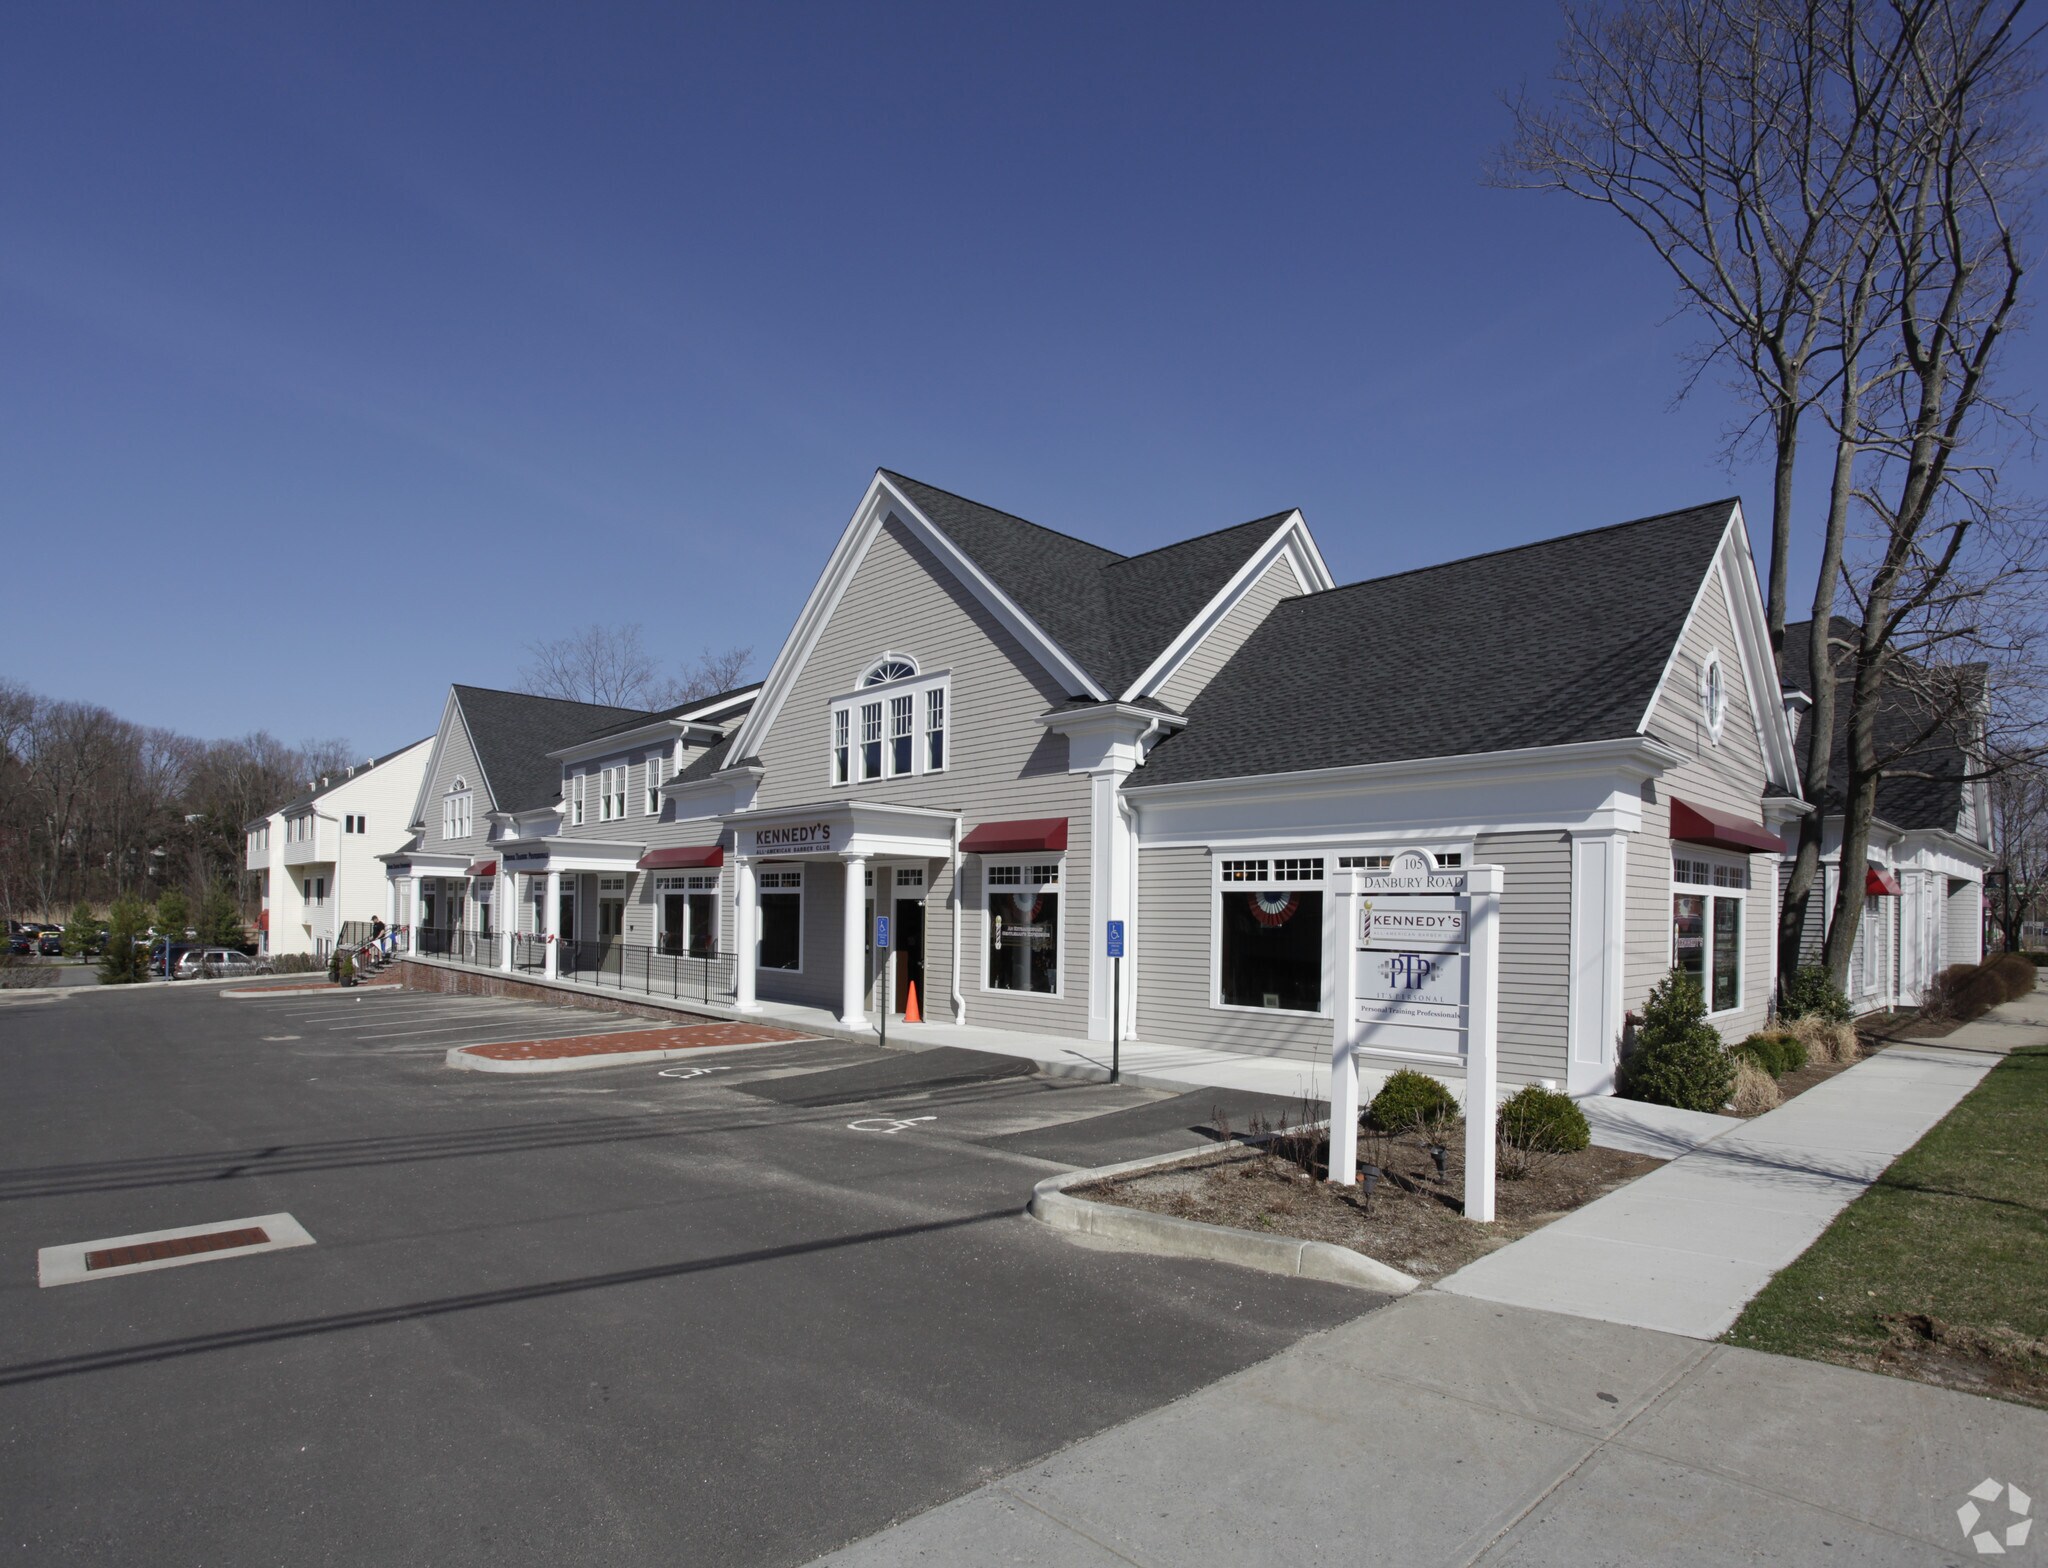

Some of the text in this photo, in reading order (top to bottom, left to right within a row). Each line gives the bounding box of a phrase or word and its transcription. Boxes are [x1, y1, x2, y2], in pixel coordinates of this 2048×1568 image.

[756, 823, 831, 844] KENNEDY'S
[1404, 858, 1423, 870] 105
[1364, 875, 1464, 889] DANBURY ROAD
[1373, 915, 1461, 928] KENNEDY'S
[1389, 953, 1431, 990] PTP
[1395, 993, 1444, 1003] PERSONAL
[1361, 1005, 1461, 1019] Personal Training Professionals
